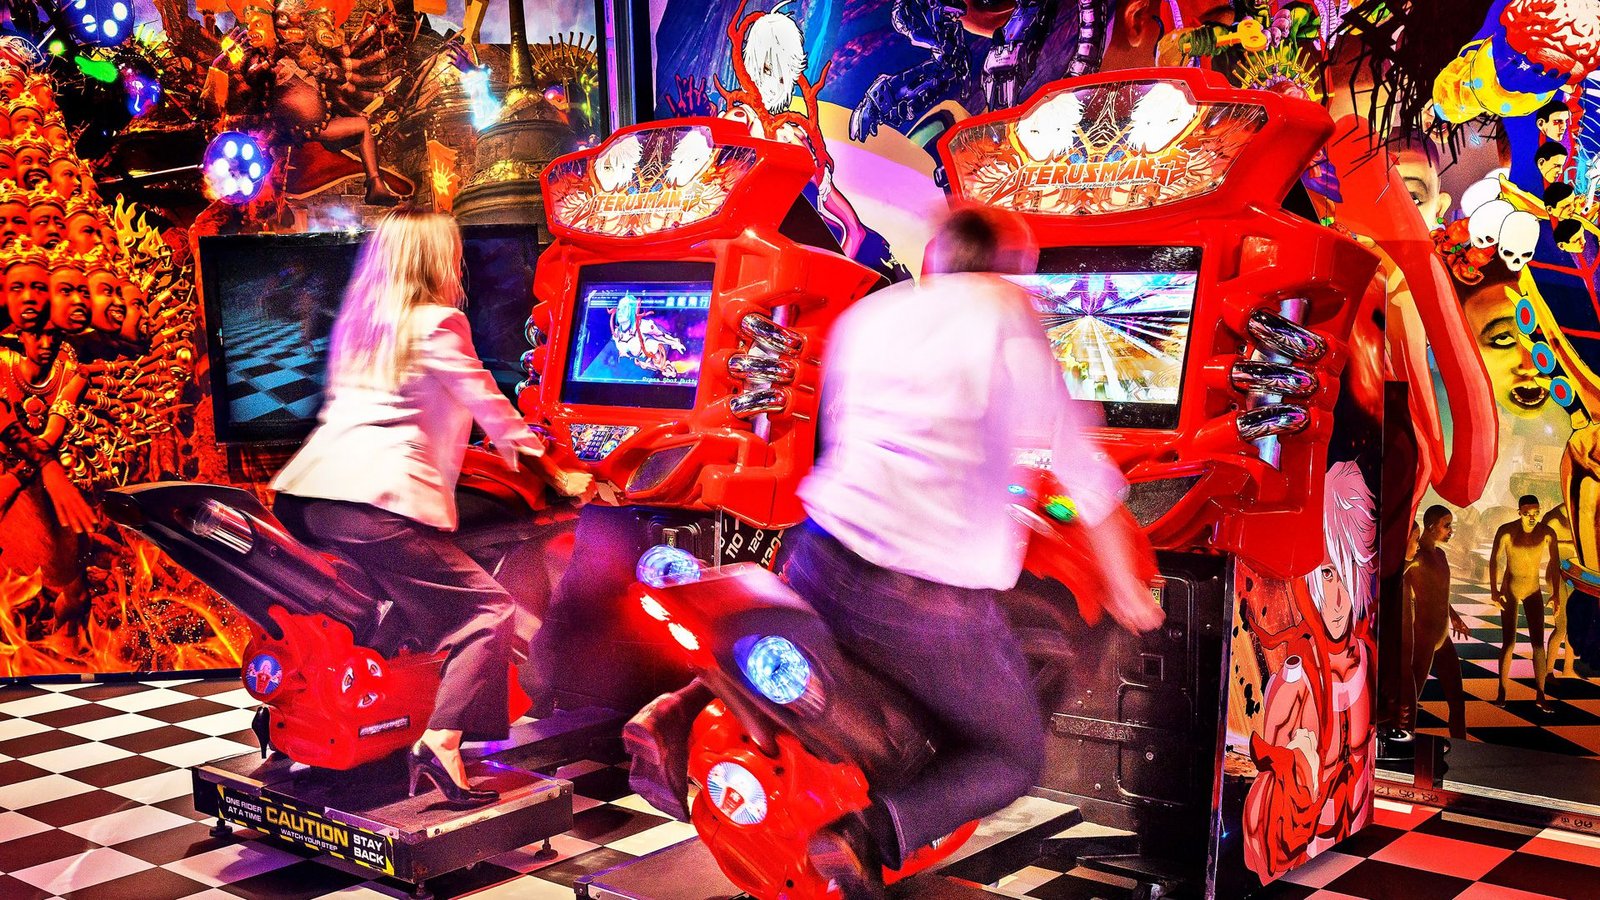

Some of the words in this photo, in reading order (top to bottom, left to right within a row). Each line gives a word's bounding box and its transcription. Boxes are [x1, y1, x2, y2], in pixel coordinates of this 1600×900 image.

[725, 532, 743, 559] 110
[748, 529, 764, 554] 120
[226, 796, 241, 807] ONE
[241, 801, 263, 813] RIDER
[228, 806, 238, 814] AT
[244, 811, 262, 822] TIME
[266, 806, 349, 847] CAUTION
[281, 828, 304, 840] WATCH
[303, 836, 321, 847] YOUR
[321, 841, 338, 851] STEP
[353, 834, 382, 851] STAY
[353, 846, 384, 865] BACK
